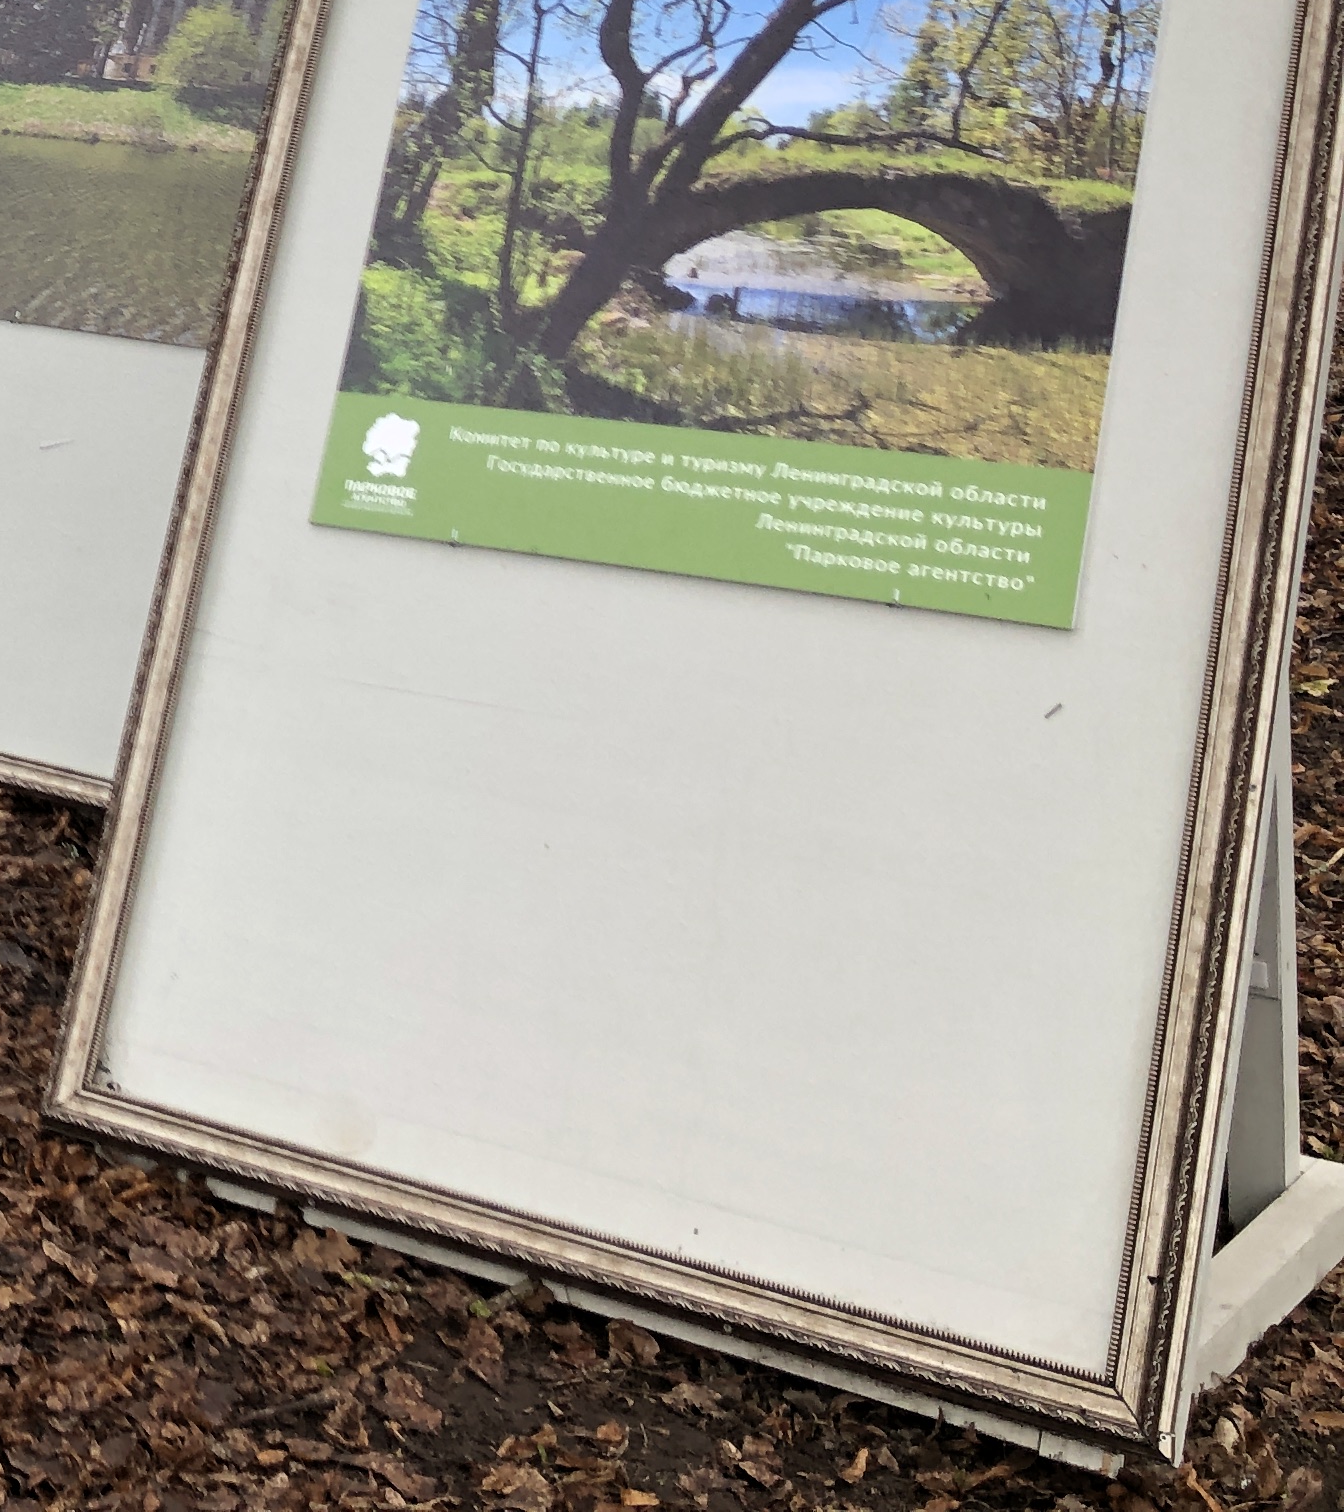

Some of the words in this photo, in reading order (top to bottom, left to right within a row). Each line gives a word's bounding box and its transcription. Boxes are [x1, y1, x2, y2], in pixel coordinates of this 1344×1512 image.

[449, 425, 532, 450] Комитет
[535, 437, 561, 454] по
[564, 441, 656, 465] культуре
[661, 452, 675, 466] и
[680, 454, 767, 479] туризму
[769, 461, 943, 498] Ленинградской
[949, 484, 1047, 510] области
[486, 454, 656, 490] Государственное
[660, 475, 782, 504] бюджетное
[787, 492, 925, 523] учреждение
[930, 510, 1043, 538] культуры
[755, 512, 927, 550] Ленинградской
[934, 538, 1031, 564] области
[785, 541, 902, 574] "Парковое
[906, 562, 1035, 591] агентство"
